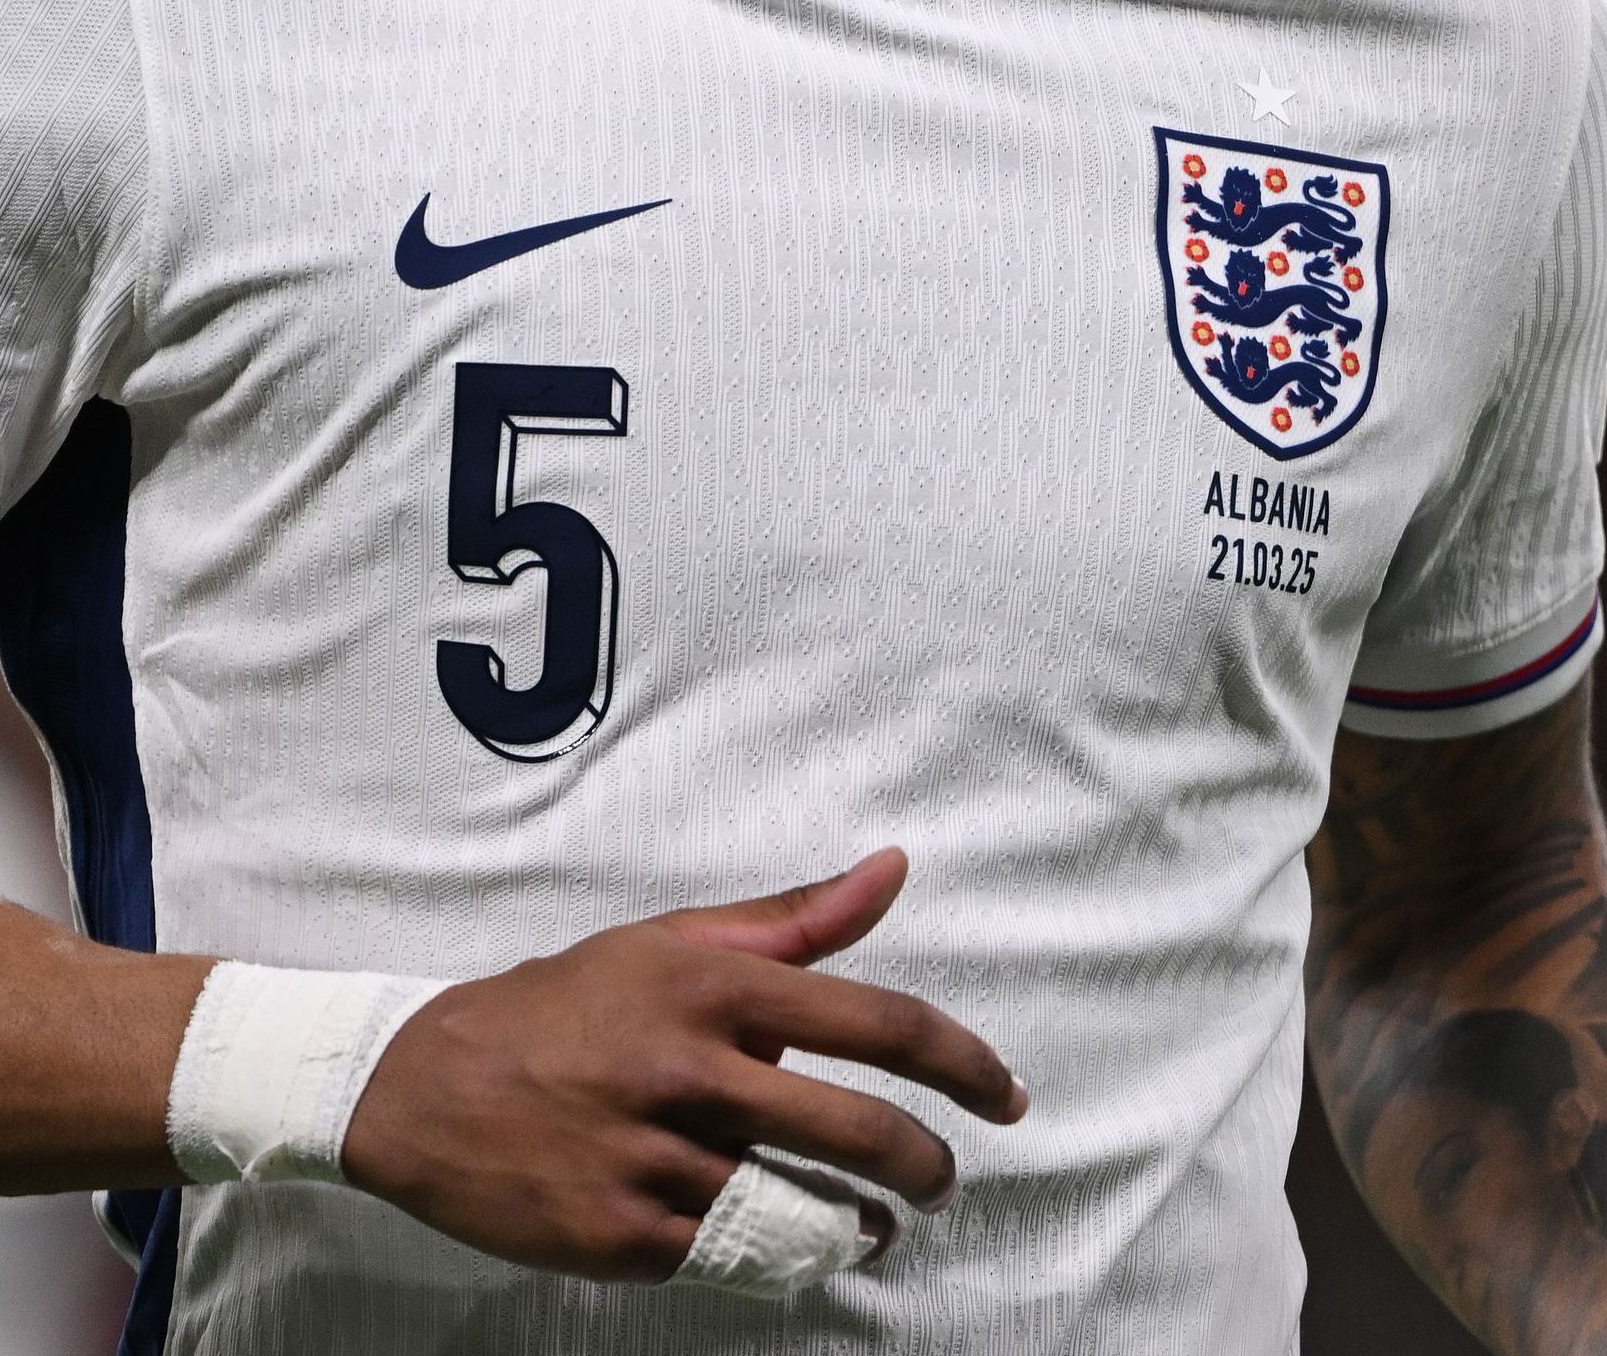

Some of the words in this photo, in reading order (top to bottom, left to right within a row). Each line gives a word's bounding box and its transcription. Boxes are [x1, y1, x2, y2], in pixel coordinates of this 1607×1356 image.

[1204, 470, 1330, 536] ALBANIA
[436, 362, 629, 764] 5
[1207, 534, 1319, 595] 21.03.25
